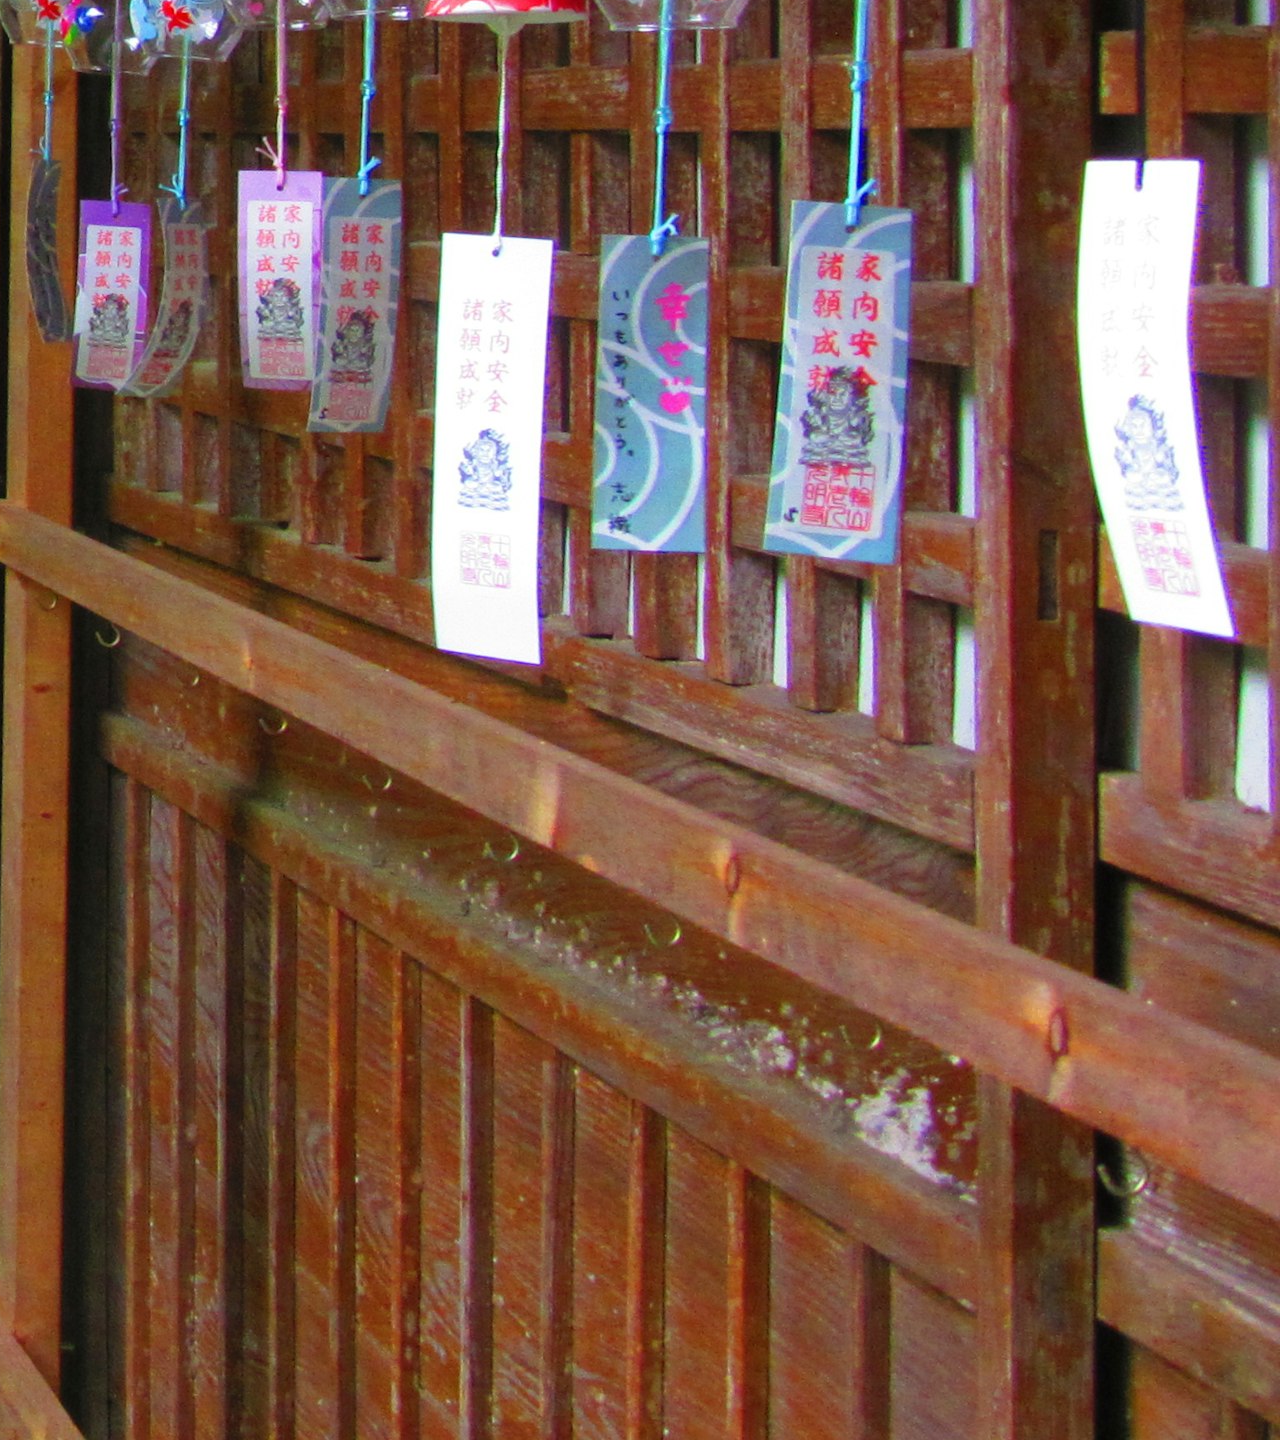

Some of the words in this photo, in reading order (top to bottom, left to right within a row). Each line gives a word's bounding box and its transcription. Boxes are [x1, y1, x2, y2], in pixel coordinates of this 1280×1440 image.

[655, 282, 691, 367] 幸せ
[1131, 214, 1161, 379] 家内安全
[483, 299, 514, 413] 家内安全
